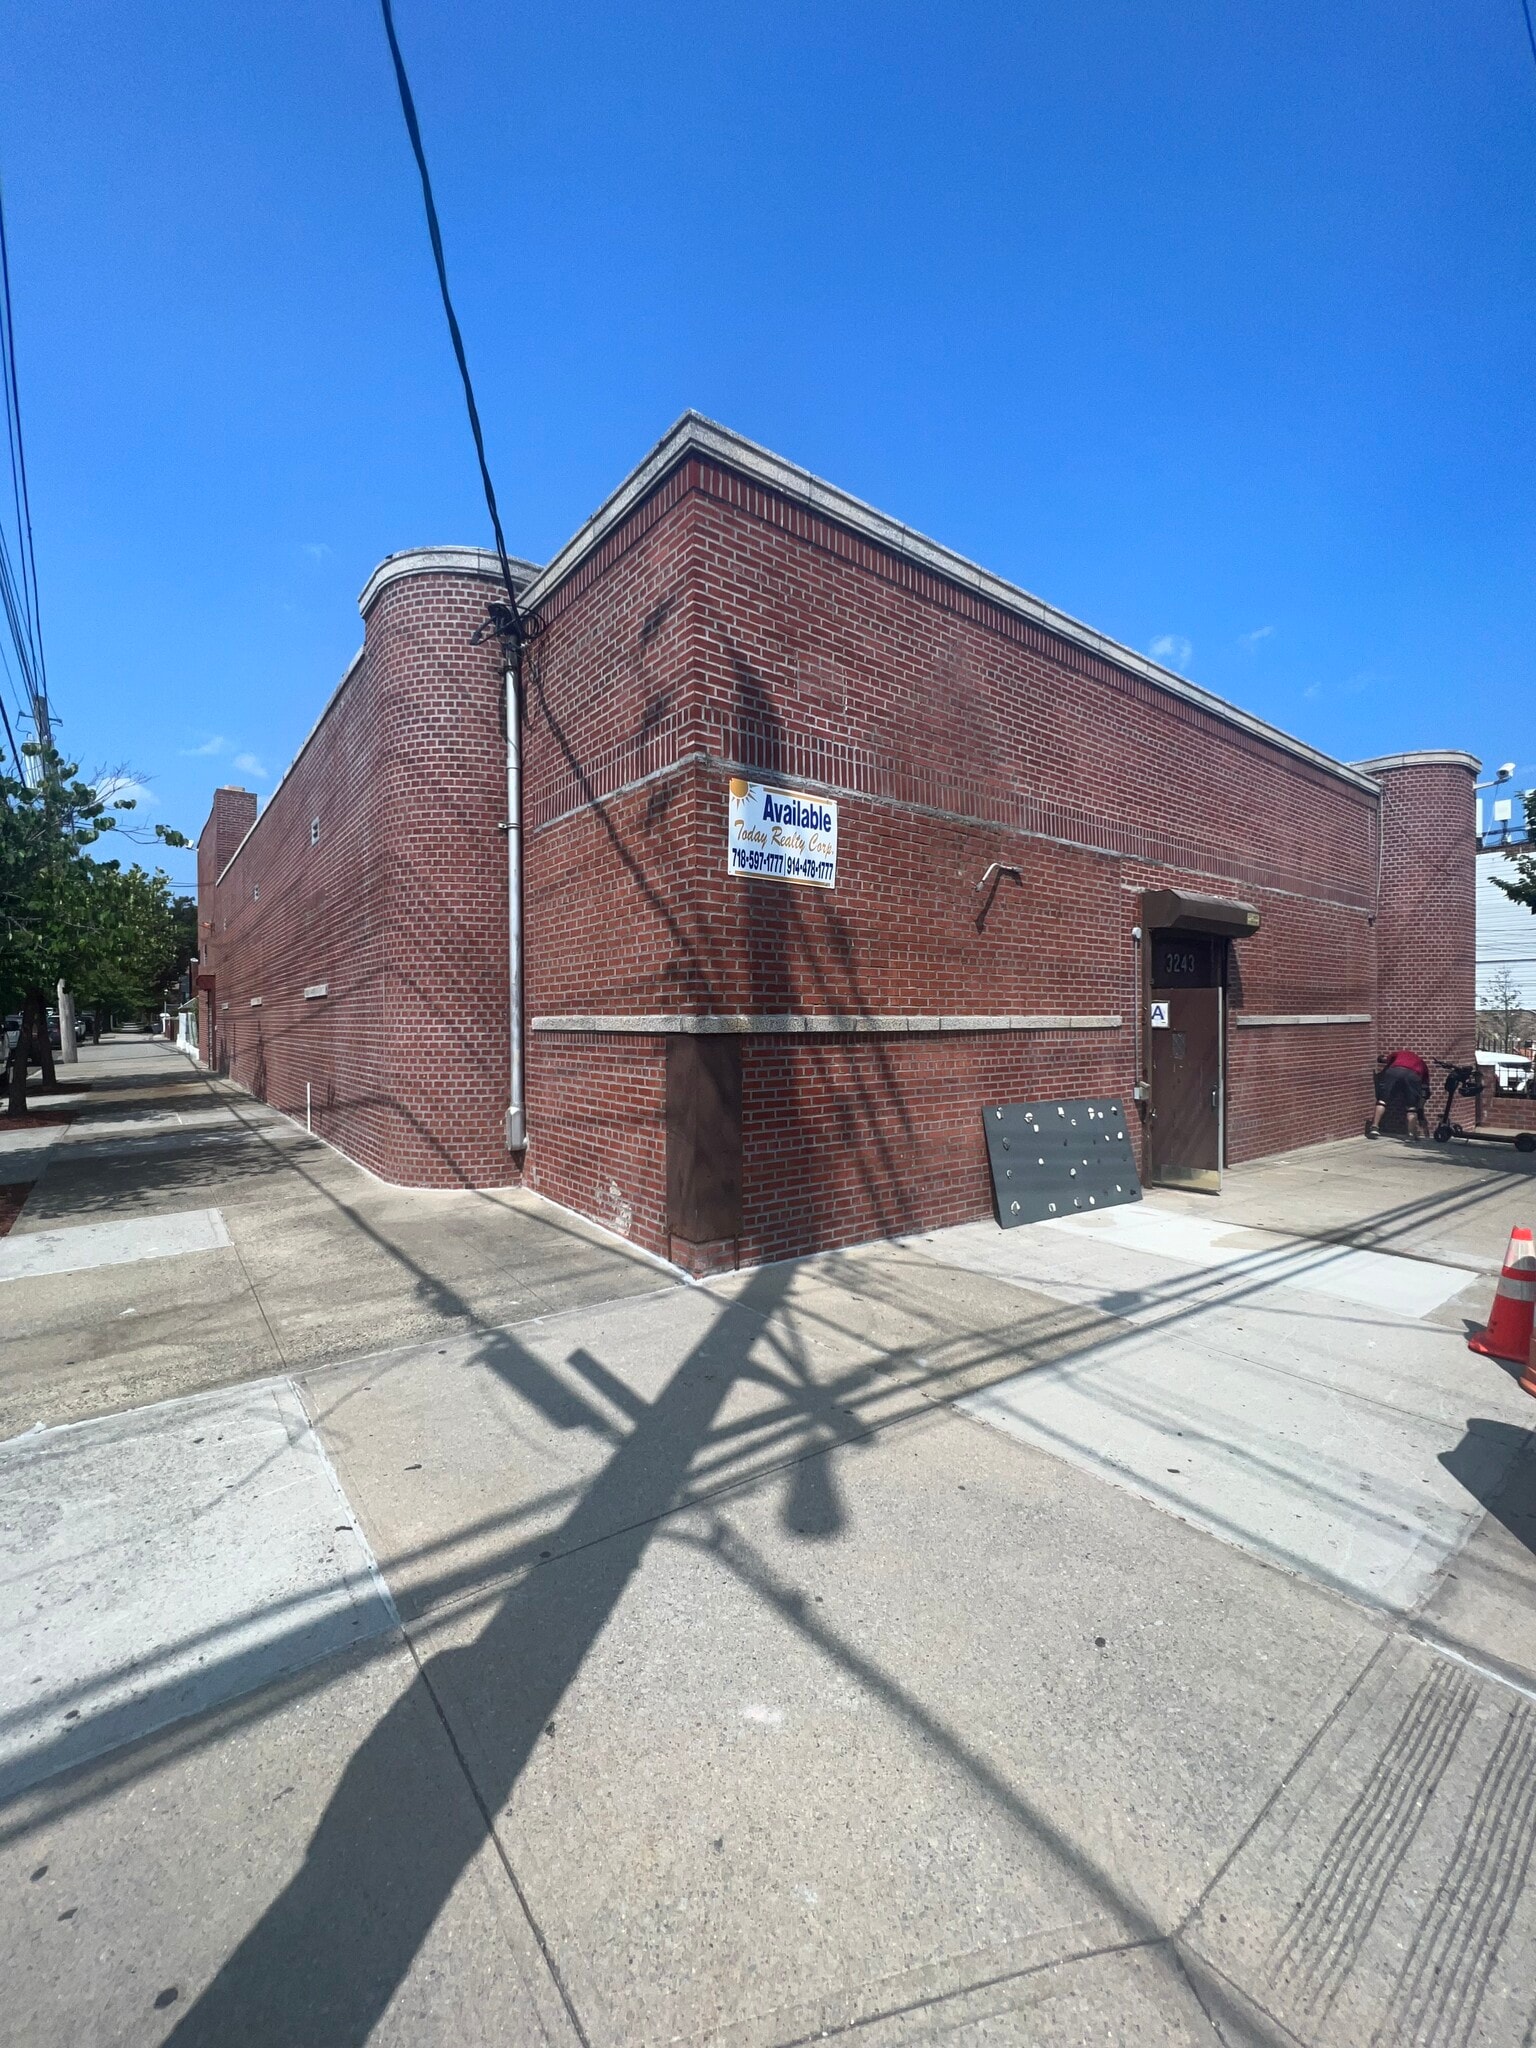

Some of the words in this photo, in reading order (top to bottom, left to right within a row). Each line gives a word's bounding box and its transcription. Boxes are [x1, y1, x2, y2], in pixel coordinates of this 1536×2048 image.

[763, 794, 831, 832] Available
[734, 819, 768, 849] Today
[771, 825, 805, 855] Realty
[809, 833, 833, 859] Corp.
[1167, 954, 1194, 972] 3243
[1151, 1005, 1164, 1020] A
